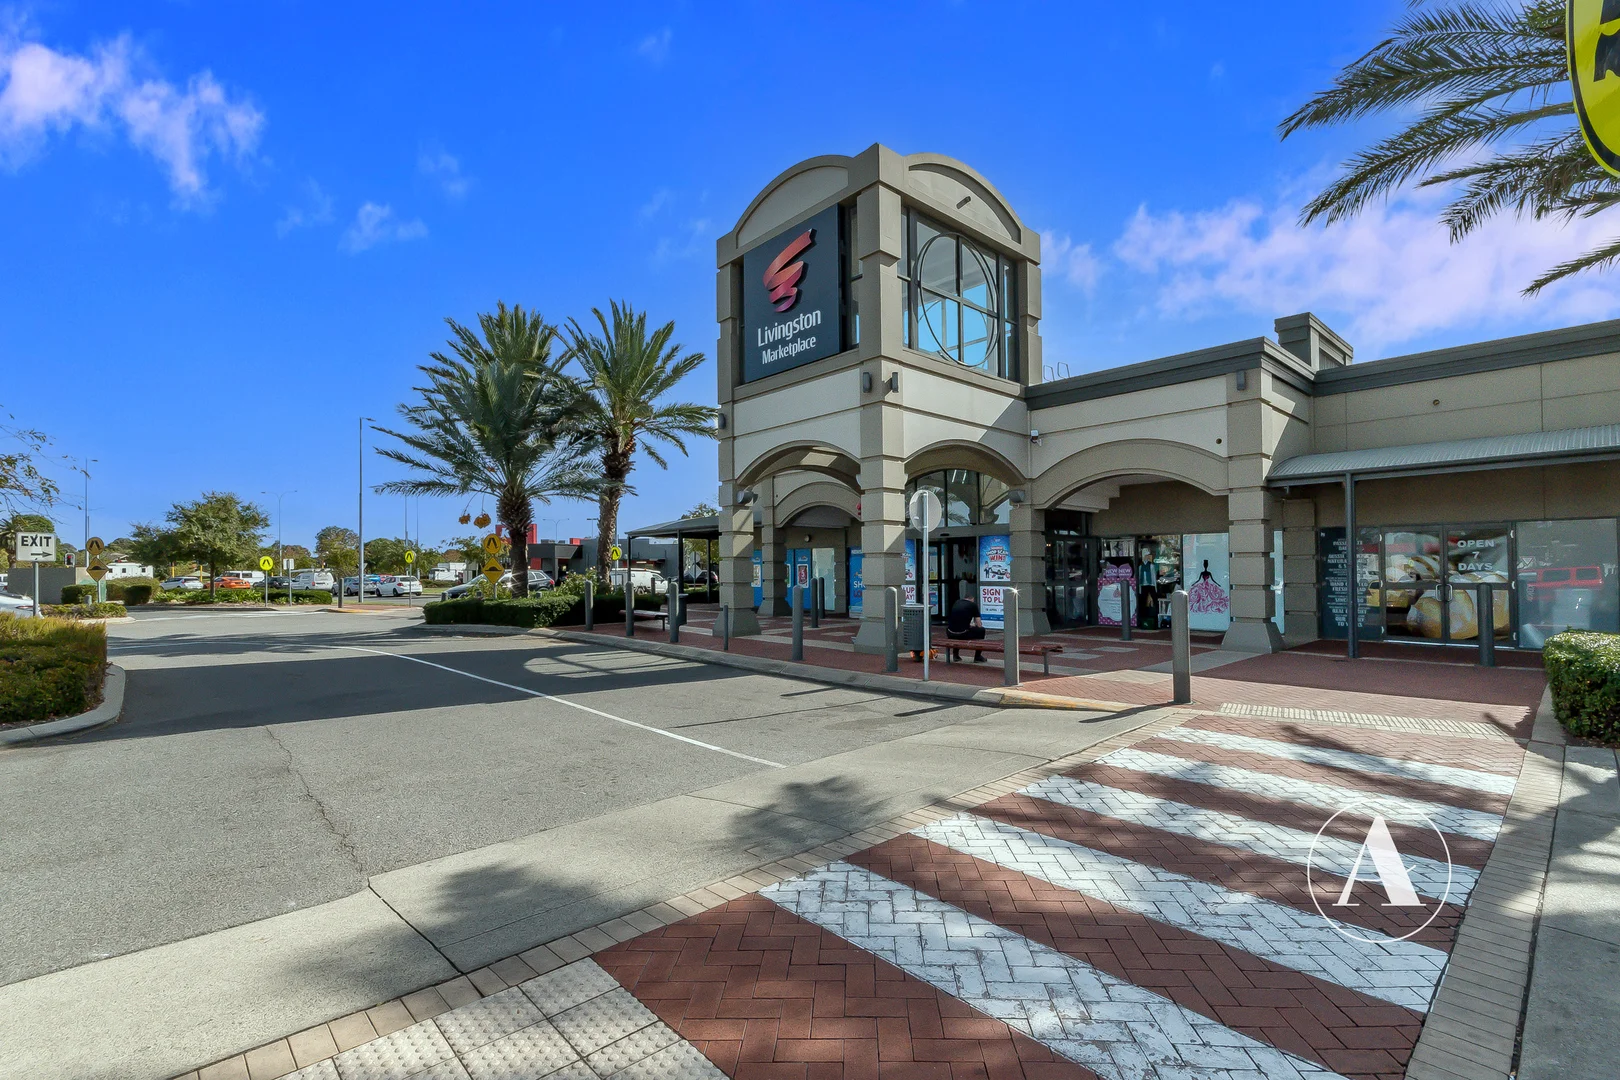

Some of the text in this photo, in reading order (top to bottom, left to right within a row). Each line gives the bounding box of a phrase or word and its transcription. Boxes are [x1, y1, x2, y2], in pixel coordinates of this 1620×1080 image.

[758, 310, 821, 347] Livingston
[762, 336, 816, 364] Marketplace
[21, 535, 52, 547] EXIT
[1457, 539, 1495, 548] OPEN
[1471, 551, 1480, 560] 7
[1458, 562, 1493, 571] DAYS
[982, 588, 1001, 596] SIGN
